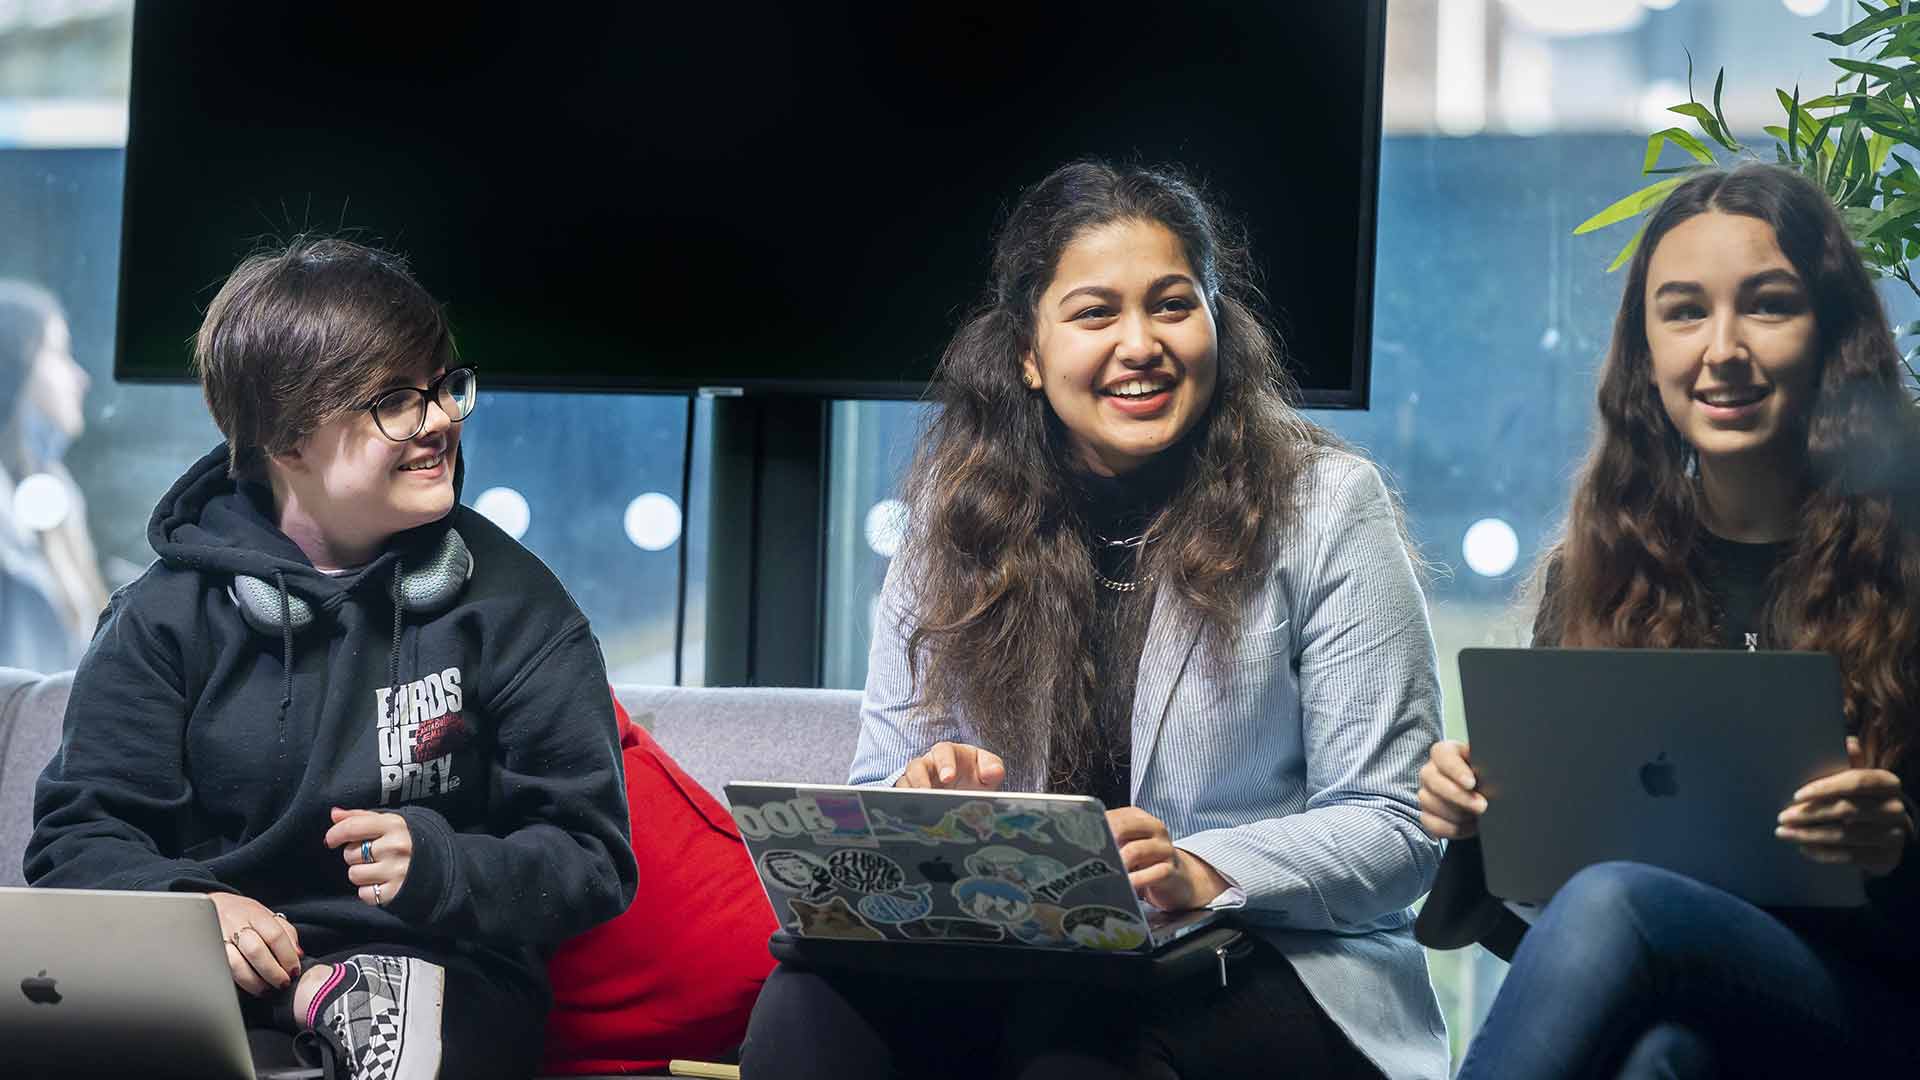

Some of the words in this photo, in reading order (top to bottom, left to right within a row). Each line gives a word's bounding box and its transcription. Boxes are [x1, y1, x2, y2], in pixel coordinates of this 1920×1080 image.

[376, 667, 462, 728] BIRDS
[378, 722, 418, 766] OF
[379, 753, 452, 805] PREY
